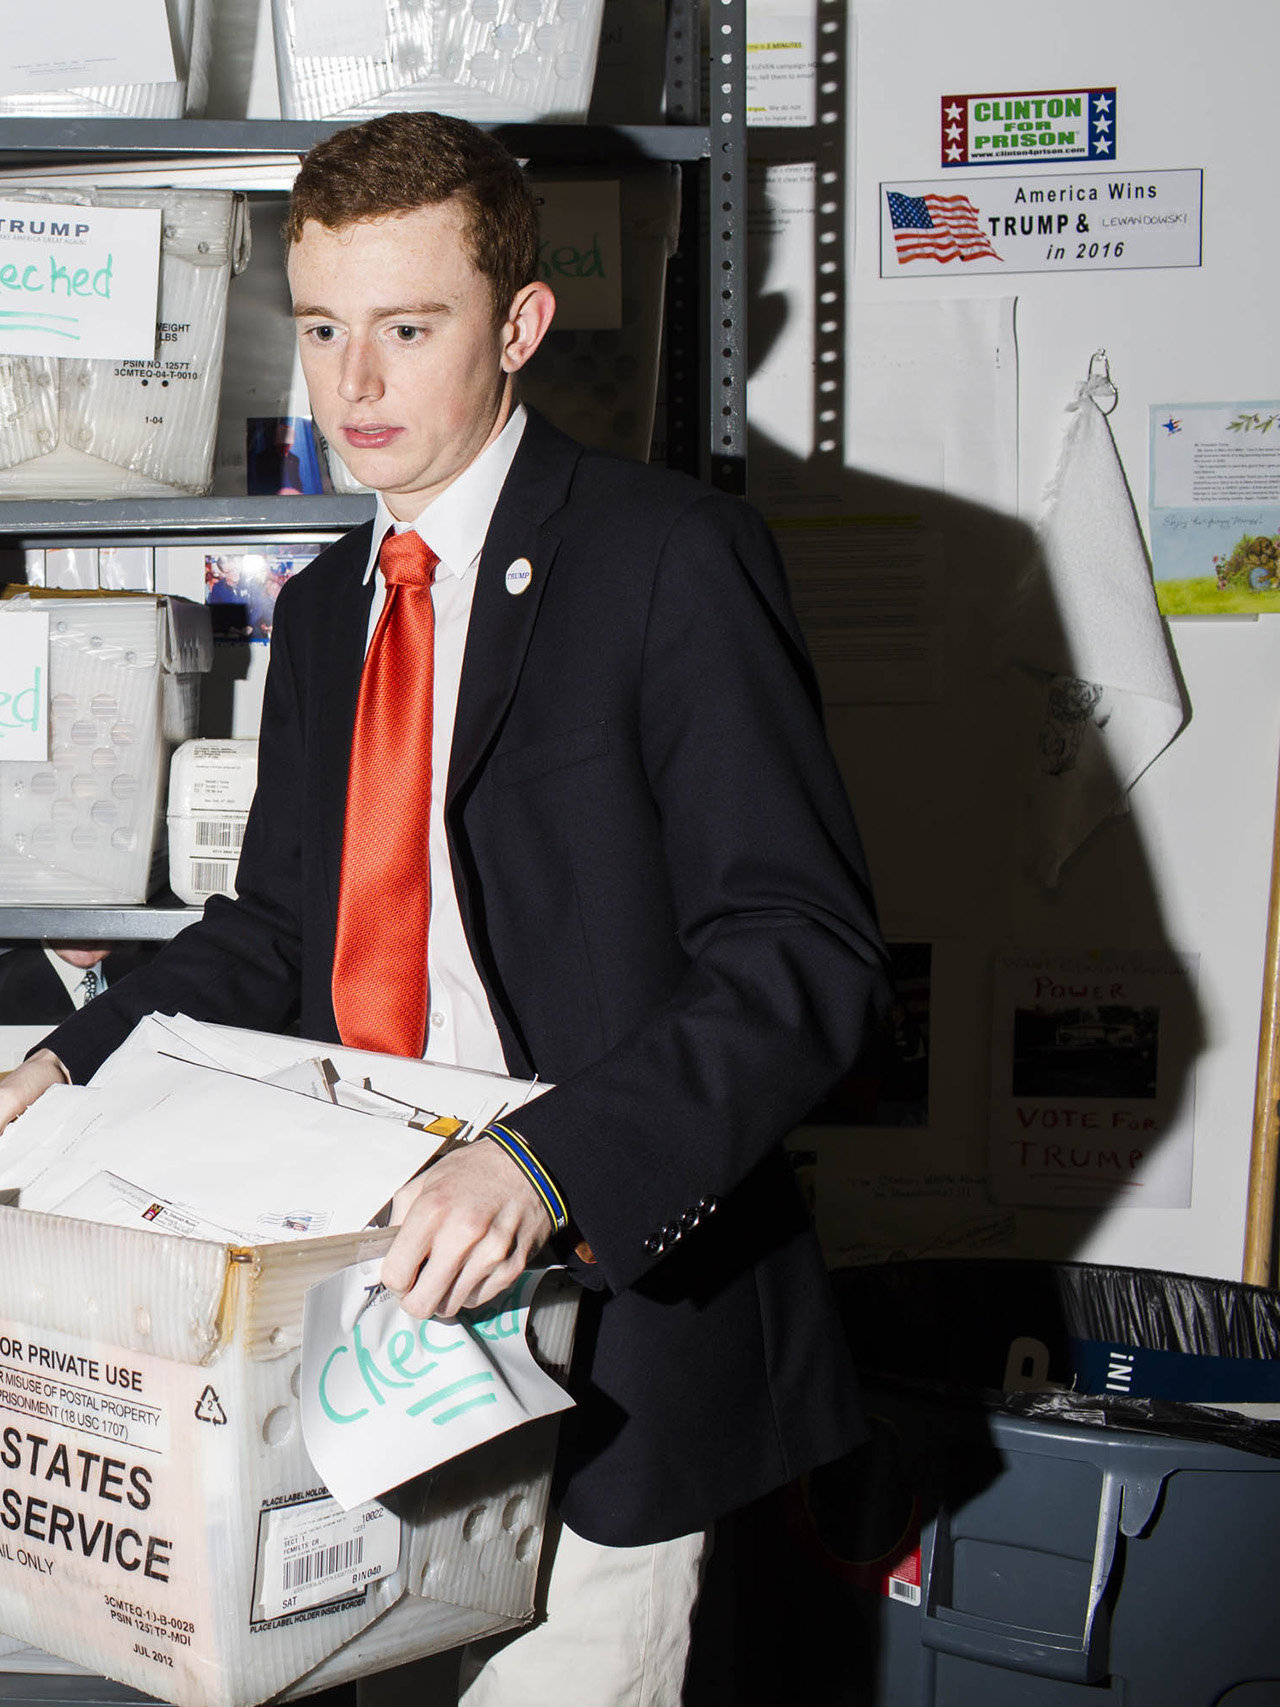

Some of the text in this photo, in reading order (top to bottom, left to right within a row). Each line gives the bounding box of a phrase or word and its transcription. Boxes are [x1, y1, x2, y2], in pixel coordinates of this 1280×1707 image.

[974, 98, 1081, 121] CLINTON
[1004, 121, 1051, 132] FOR
[975, 132, 1075, 149] PRISON
[971, 147, 1085, 158] www.clinton4prison.com
[1015, 183, 1156, 203] America Wins
[988, 214, 1089, 236] TRUMP &
[1102, 214, 1186, 227] LEWANDOWSKI
[1047, 242, 1124, 259] in 2016
[159, 332, 177, 341] LBS
[123, 360, 190, 370] PSIN NO. 1257T
[507, 572, 529, 580] TRUMP
[1016, 1108, 1097, 1128] VOTE
[1011, 1141, 1143, 1168] TRUMP
[318, 1271, 533, 1424] Checed
[29, 1344, 99, 1381] PRIVATE
[106, 1364, 142, 1392] USE
[1, 1427, 152, 1510] STATES
[362, 1508, 384, 1523] 10022
[1, 1489, 173, 1583] SERVICE
[18, 1550, 53, 1575] ONLY
[352, 1565, 381, 1583] BIN040
[282, 1596, 297, 1609] SAT
[133, 1643, 173, 1667] JUL 2012
